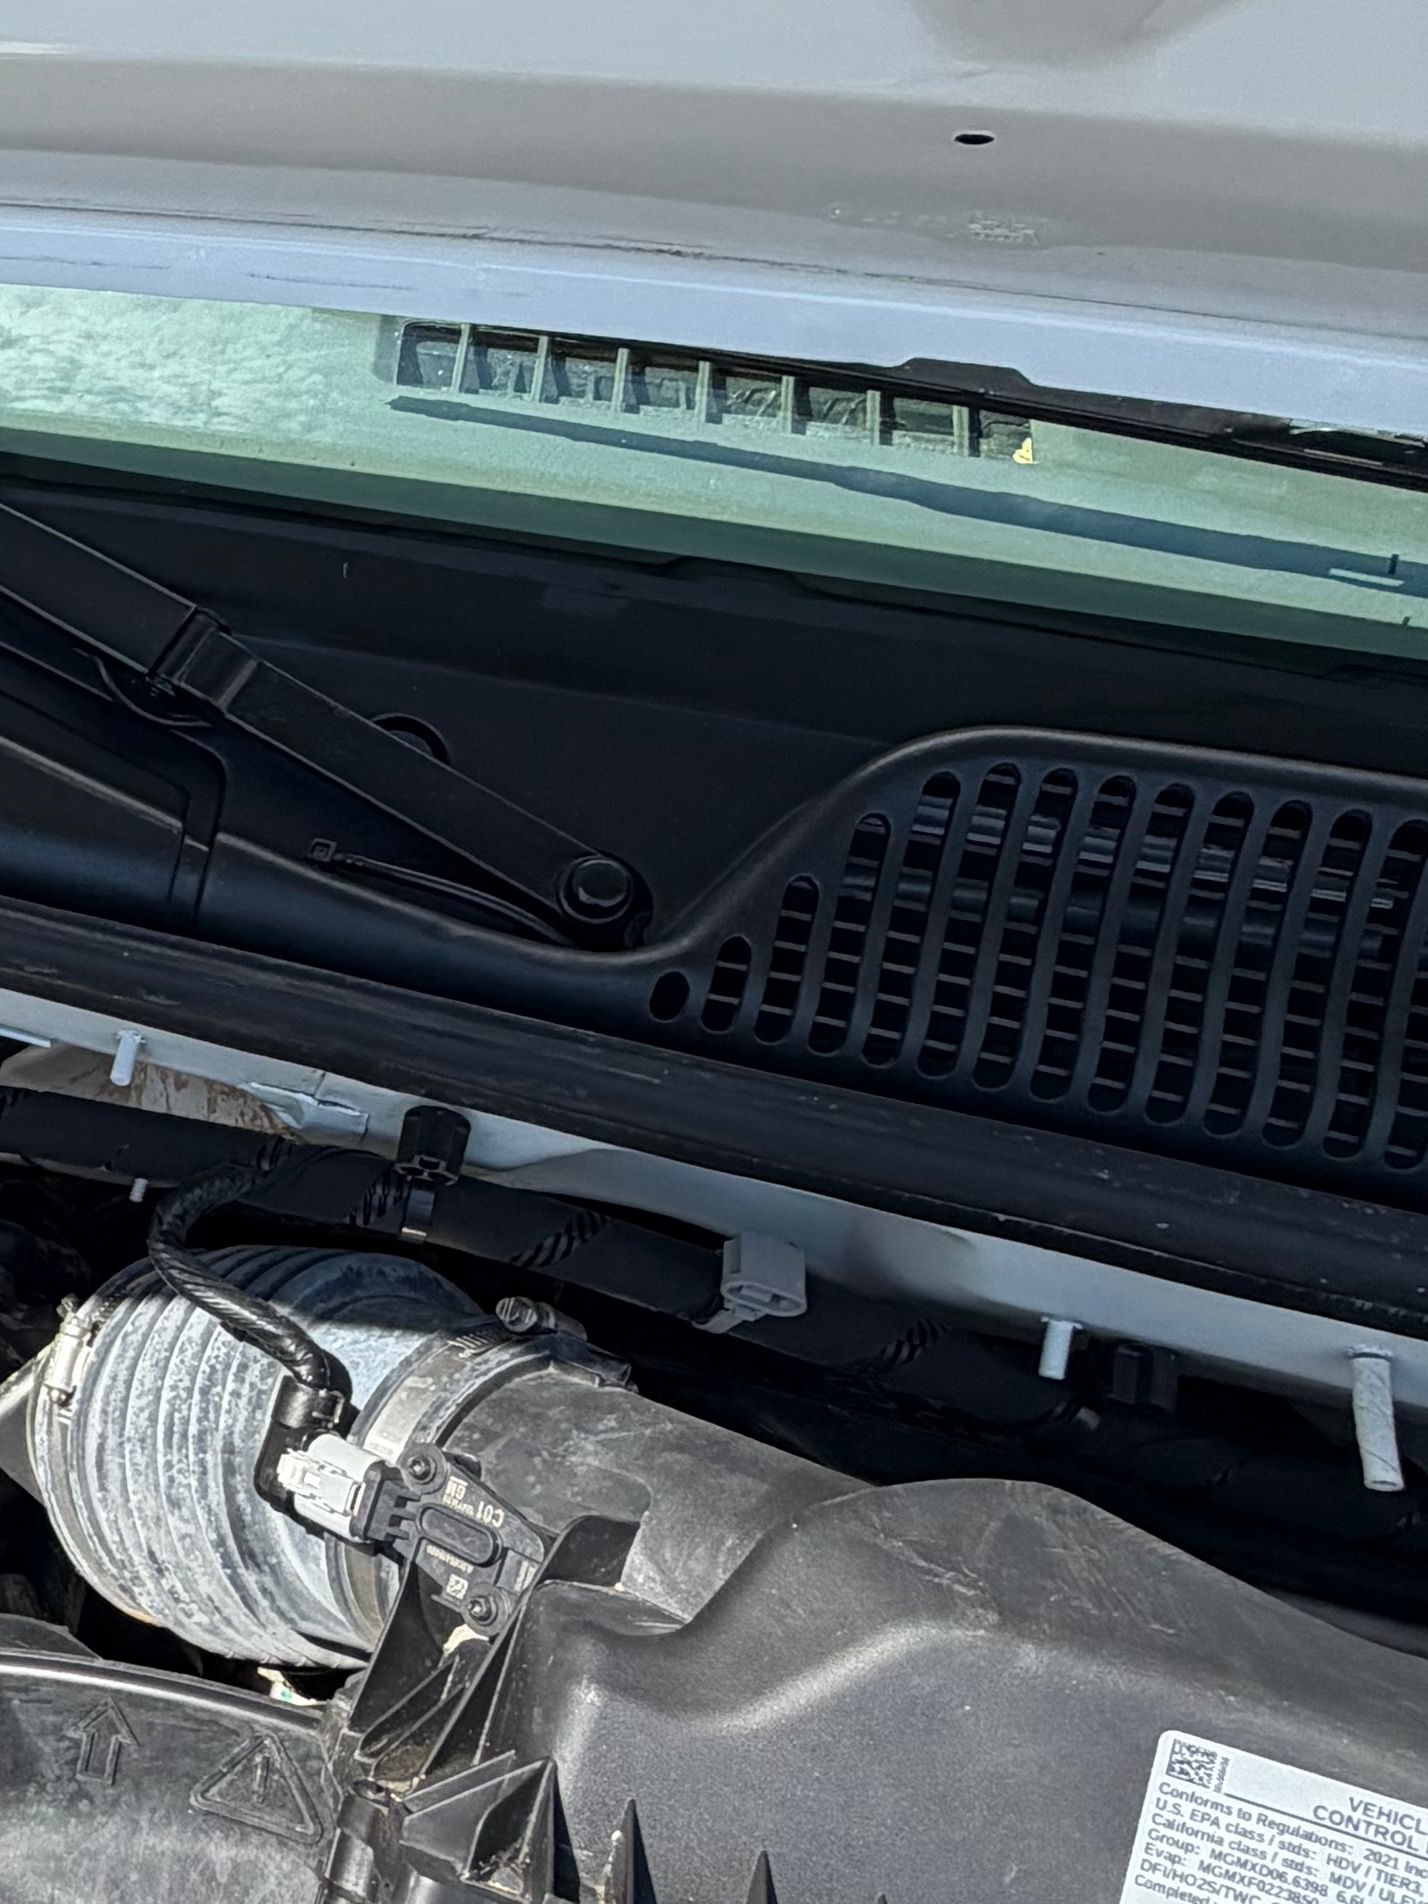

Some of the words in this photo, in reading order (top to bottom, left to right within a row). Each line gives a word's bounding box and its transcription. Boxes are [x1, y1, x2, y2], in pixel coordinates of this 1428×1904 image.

[1143, 1842, 1188, 1867] Evap:
[1146, 1827, 1201, 1856] Group:
[1150, 1812, 1227, 1847] California
[1227, 1837, 1269, 1860] class
[1280, 1854, 1321, 1877] stds:
[1329, 1872, 1368, 1892] MDV
[1154, 1797, 1186, 1817] U.S.
[1188, 1808, 1222, 1829] EPA
[1224, 1819, 1267, 1843] class
[1277, 1836, 1318, 1860] stds:
[1326, 1854, 1362, 1874] HDV
[1157, 1781, 1234, 1817] Conforms
[1235, 1807, 1254, 1822] to
[1254, 1812, 1354, 1858] Regulations:
[1363, 1848, 1400, 1870] 2021
[1312, 1804, 1420, 1852] CONTROL
